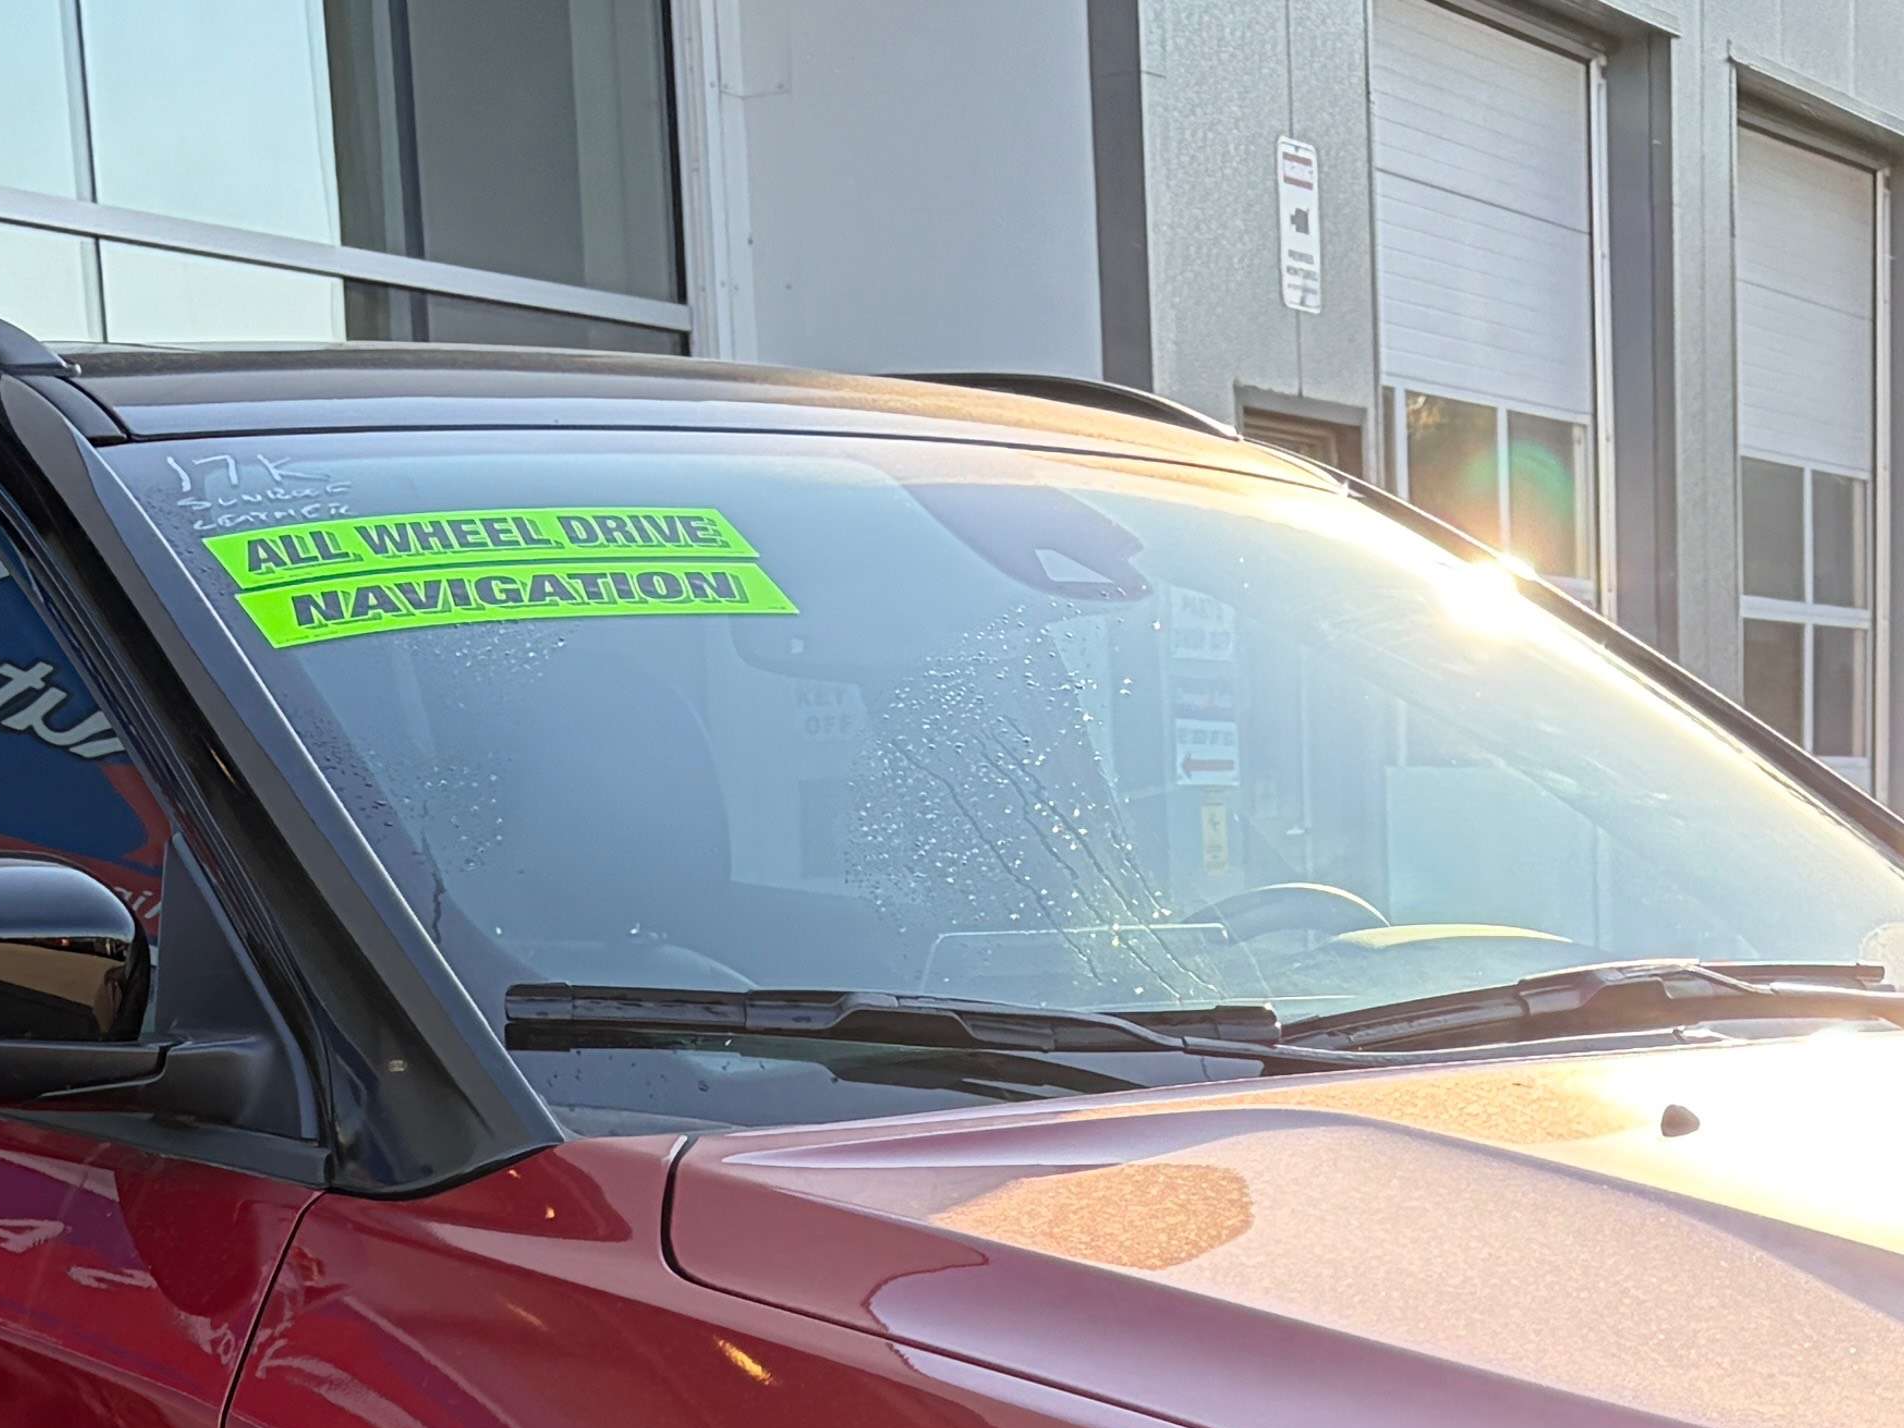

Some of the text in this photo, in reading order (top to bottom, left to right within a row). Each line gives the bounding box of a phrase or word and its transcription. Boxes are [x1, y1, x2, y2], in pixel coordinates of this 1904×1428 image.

[246, 513, 729, 575] ALL WHEEL DRIVE
[290, 570, 749, 630] NAVIGATION
